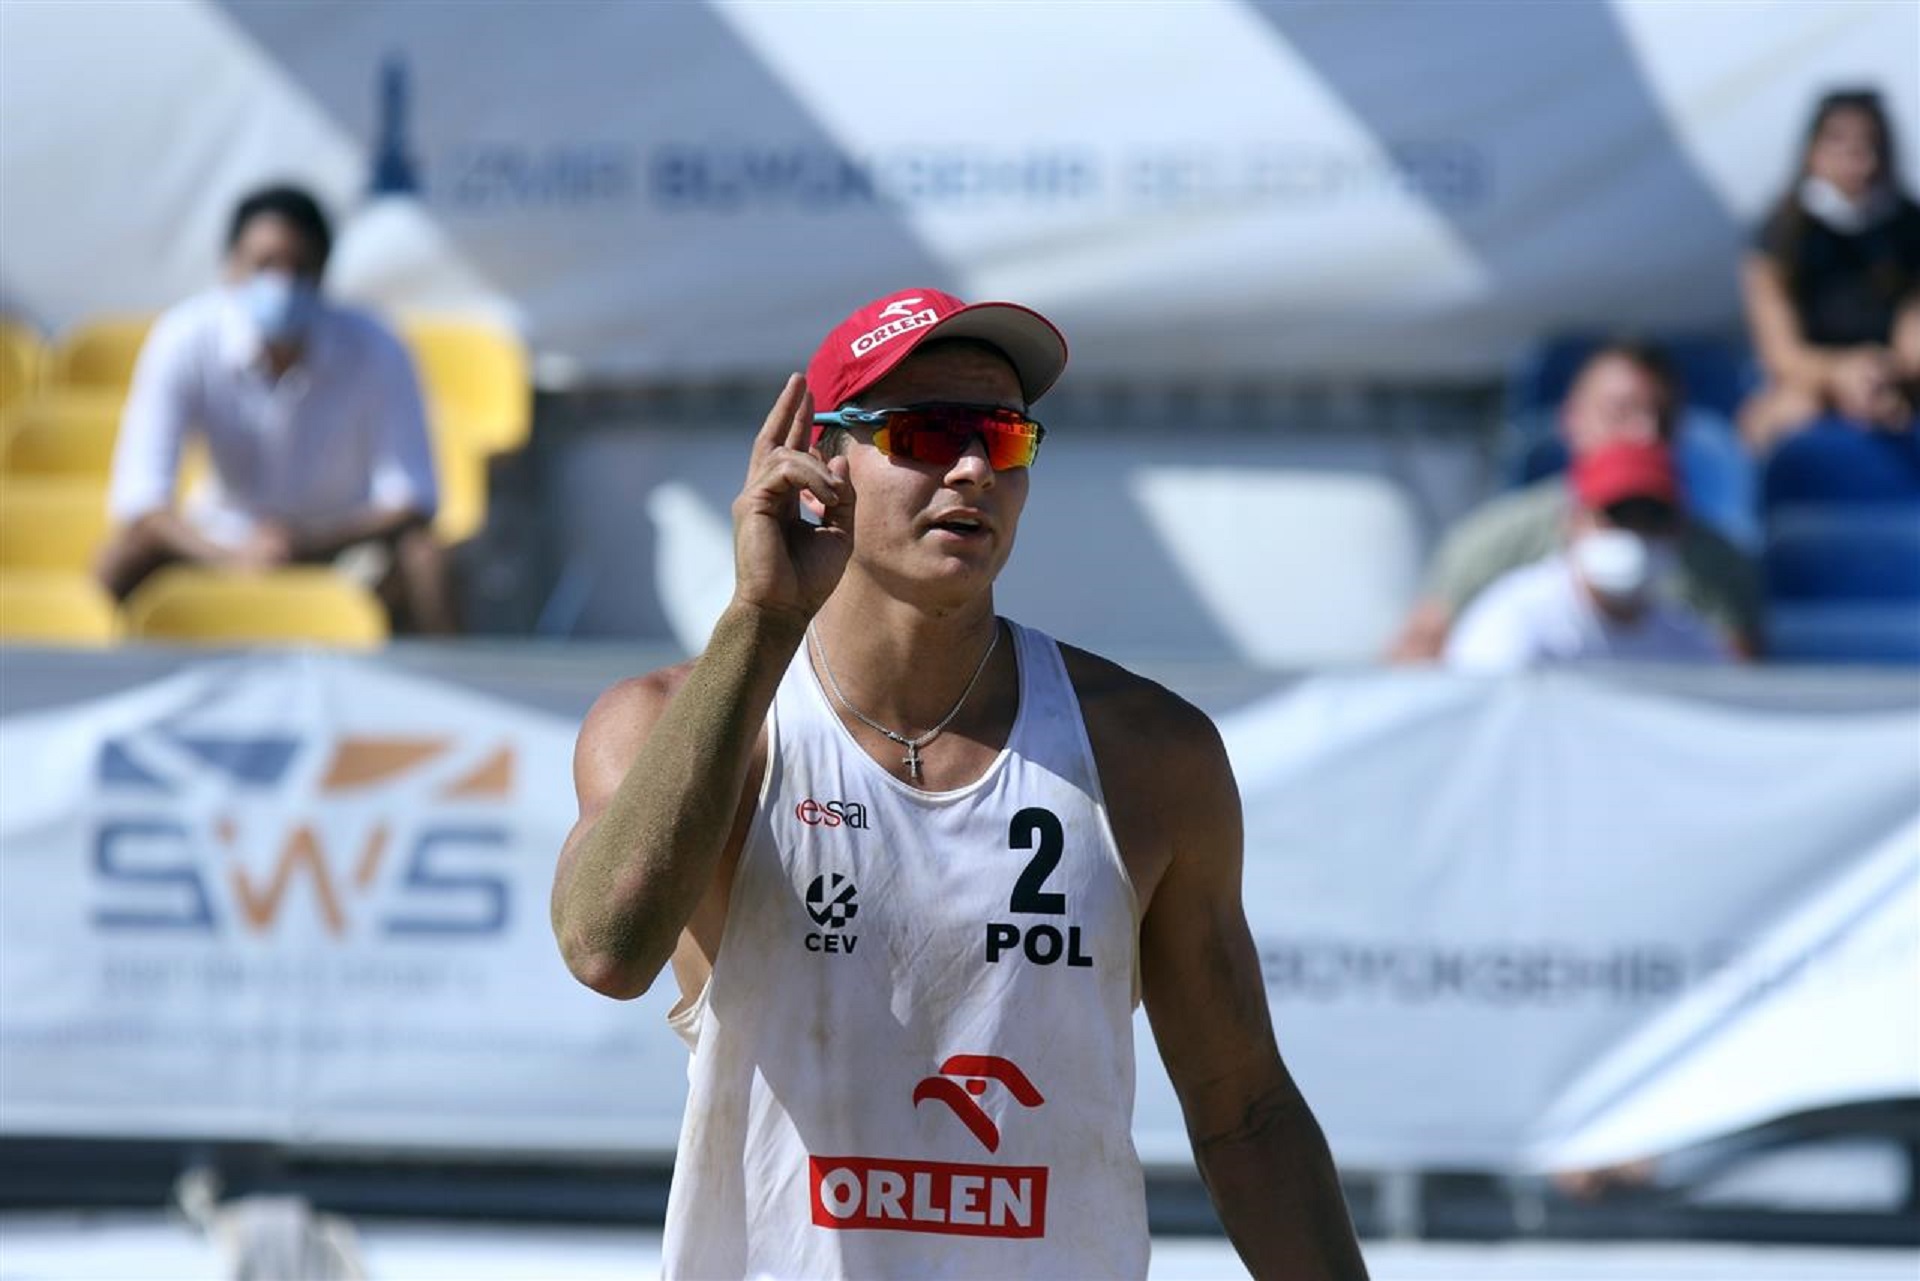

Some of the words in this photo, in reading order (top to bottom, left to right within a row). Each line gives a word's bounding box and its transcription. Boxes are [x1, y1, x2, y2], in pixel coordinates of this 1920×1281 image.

[857, 311, 933, 351] ORLEN
[90, 815, 513, 940] SWS
[1008, 806, 1067, 916] 2
[804, 932, 858, 955] CEV
[985, 922, 1094, 968] POL
[820, 1166, 1033, 1227] ORLEN
